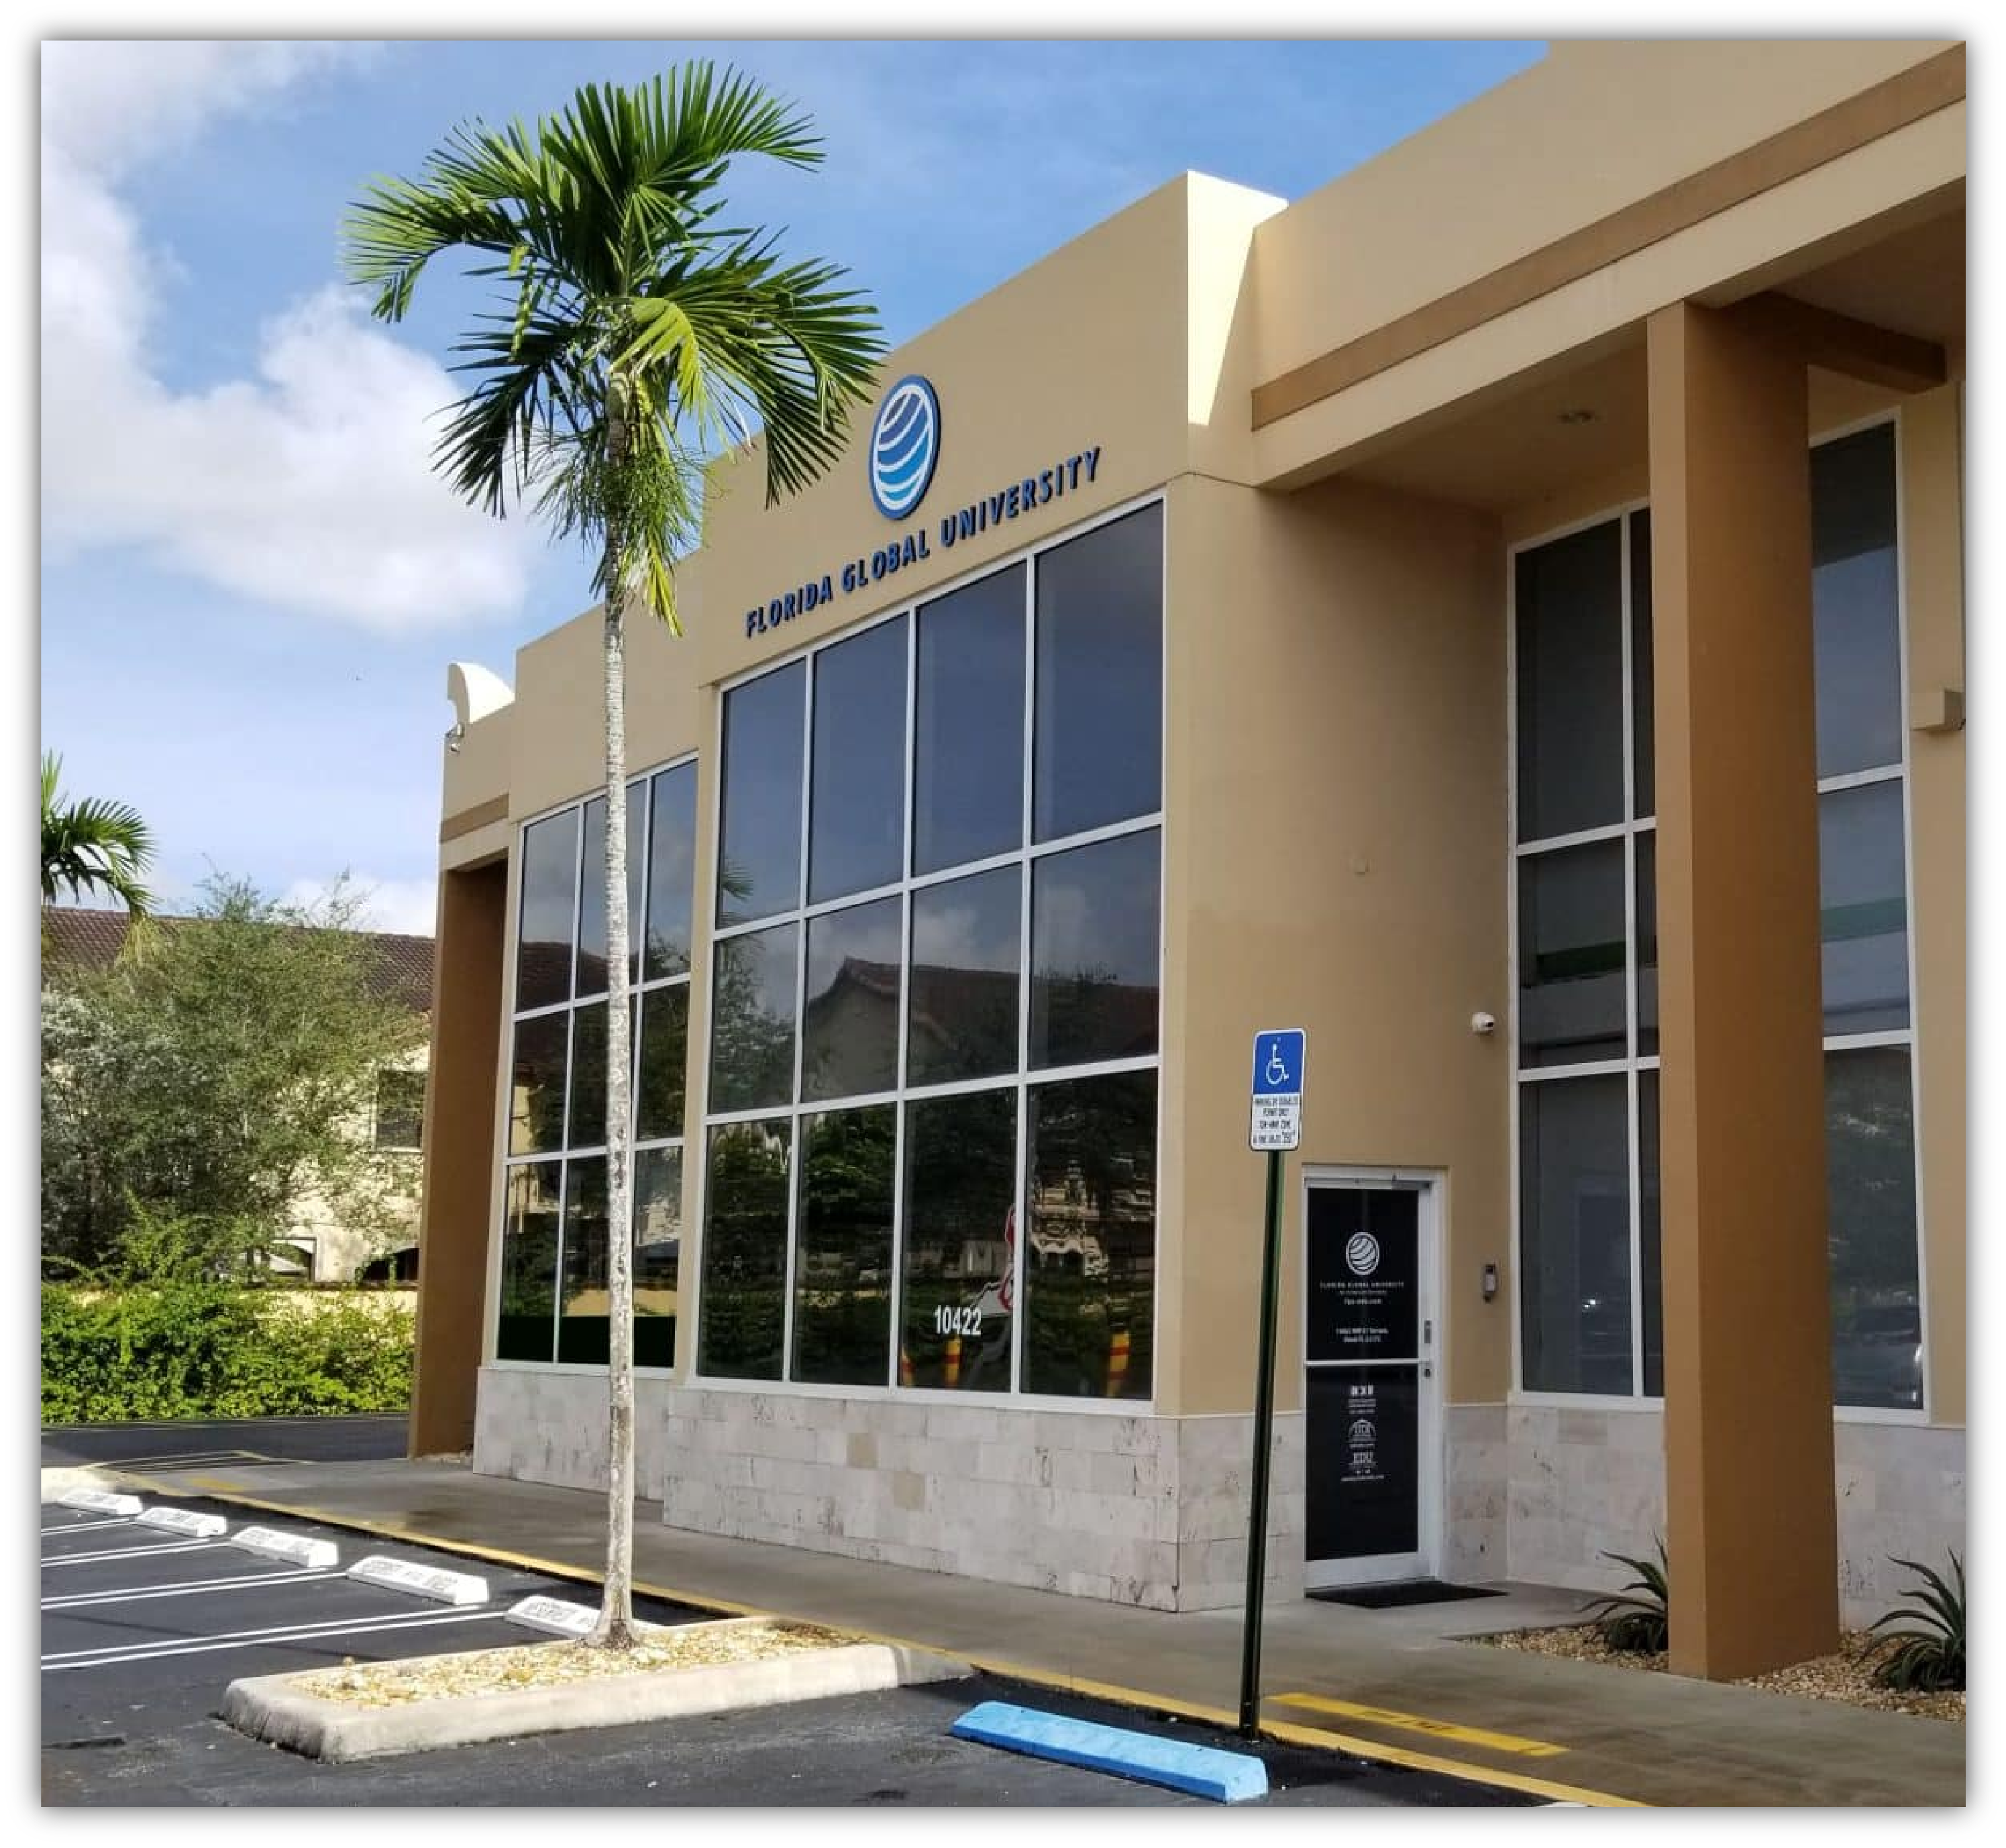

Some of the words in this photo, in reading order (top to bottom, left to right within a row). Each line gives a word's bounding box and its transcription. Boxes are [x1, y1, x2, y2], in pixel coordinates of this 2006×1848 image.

[745, 575, 834, 638] FLORIDA
[840, 529, 931, 594] GLOBAL
[941, 446, 1102, 548] UNIVERSITY
[933, 1305, 982, 1336] 10422
